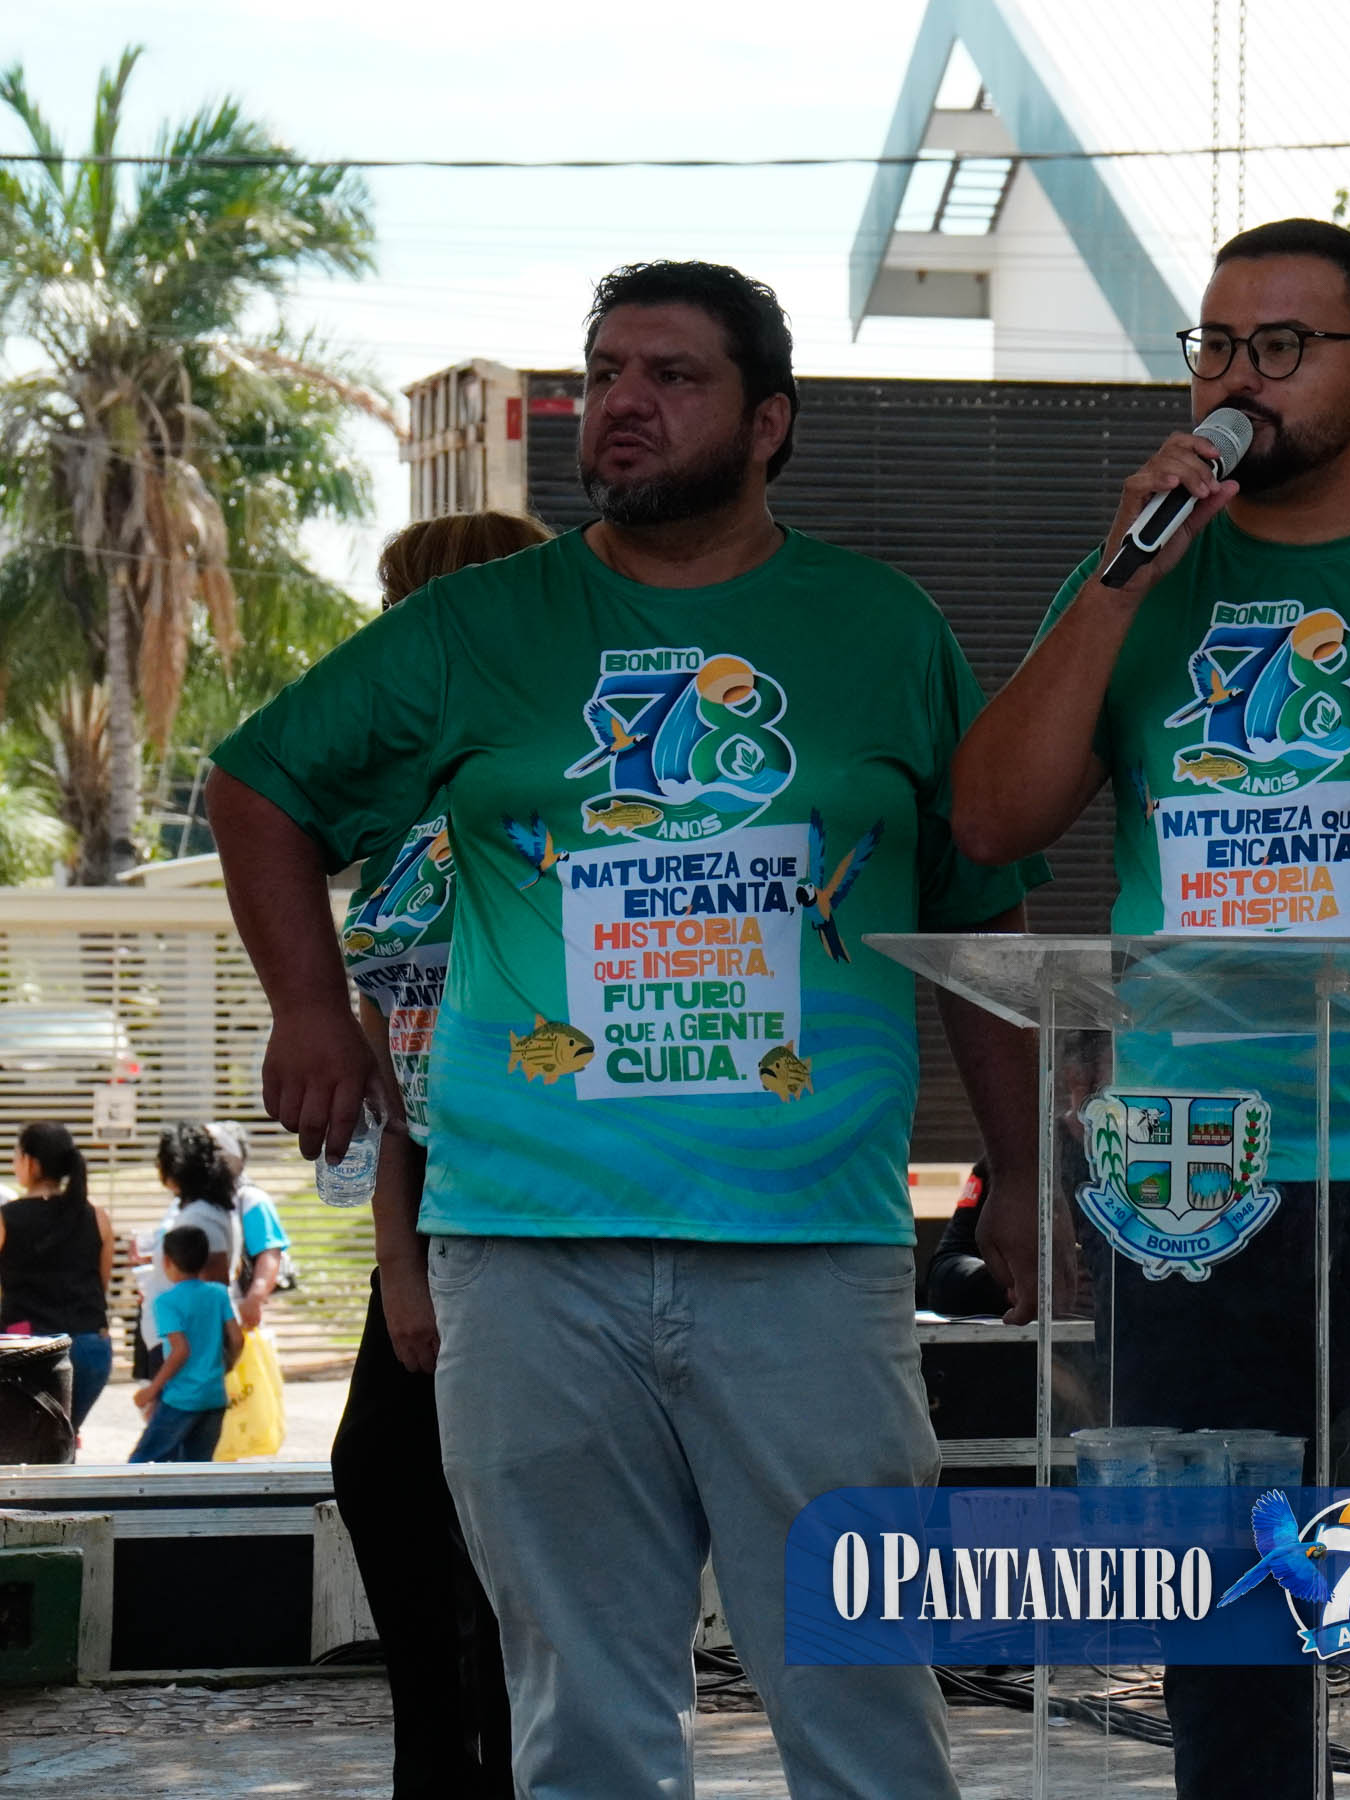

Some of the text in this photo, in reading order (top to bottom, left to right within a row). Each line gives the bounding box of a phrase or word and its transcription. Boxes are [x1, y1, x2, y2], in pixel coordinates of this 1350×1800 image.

[1214, 604, 1300, 625] BONITO
[604, 650, 700, 673] BONITO
[597, 653, 797, 800] 78
[1239, 771, 1300, 795] ANOS
[655, 814, 722, 840] ANOS
[1162, 804, 1312, 839] NATUREZA
[571, 851, 797, 889] NATUREZA QUE
[1181, 856, 1335, 901] HISTÓRIA
[624, 881, 796, 919] ENCANTA,
[593, 904, 763, 951] HISTÓRIA
[593, 957, 637, 982] QUE
[603, 980, 746, 1013] FUTURO
[604, 1012, 785, 1046] QUE A GENTE
[606, 1046, 748, 1084] CUIDA.
[1146, 1235, 1211, 1254] BONITO
